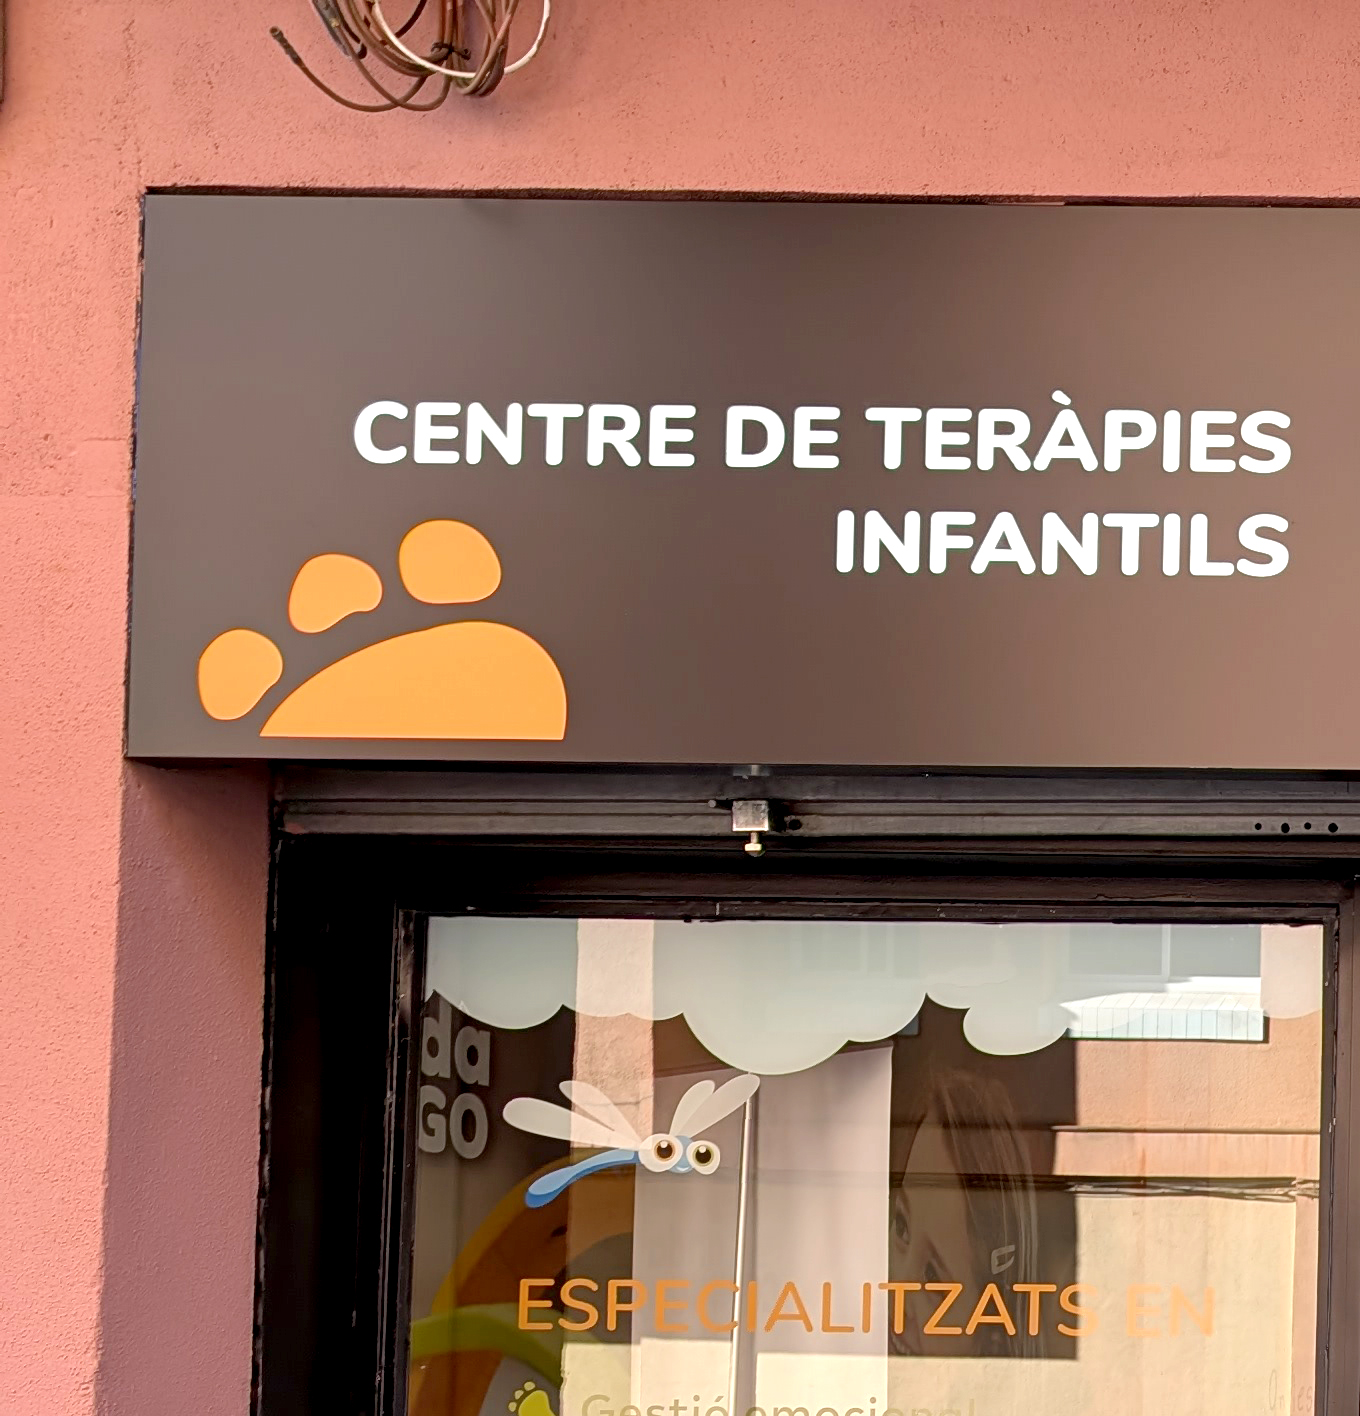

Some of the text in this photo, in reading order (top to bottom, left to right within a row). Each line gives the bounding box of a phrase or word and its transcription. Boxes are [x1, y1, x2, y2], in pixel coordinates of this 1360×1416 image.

[354, 390, 1293, 474] CENTRE DE TERÀPIES
[836, 509, 1290, 577] INFANTILS
[518, 1278, 1216, 1338] ESPECIALITZATS EN
